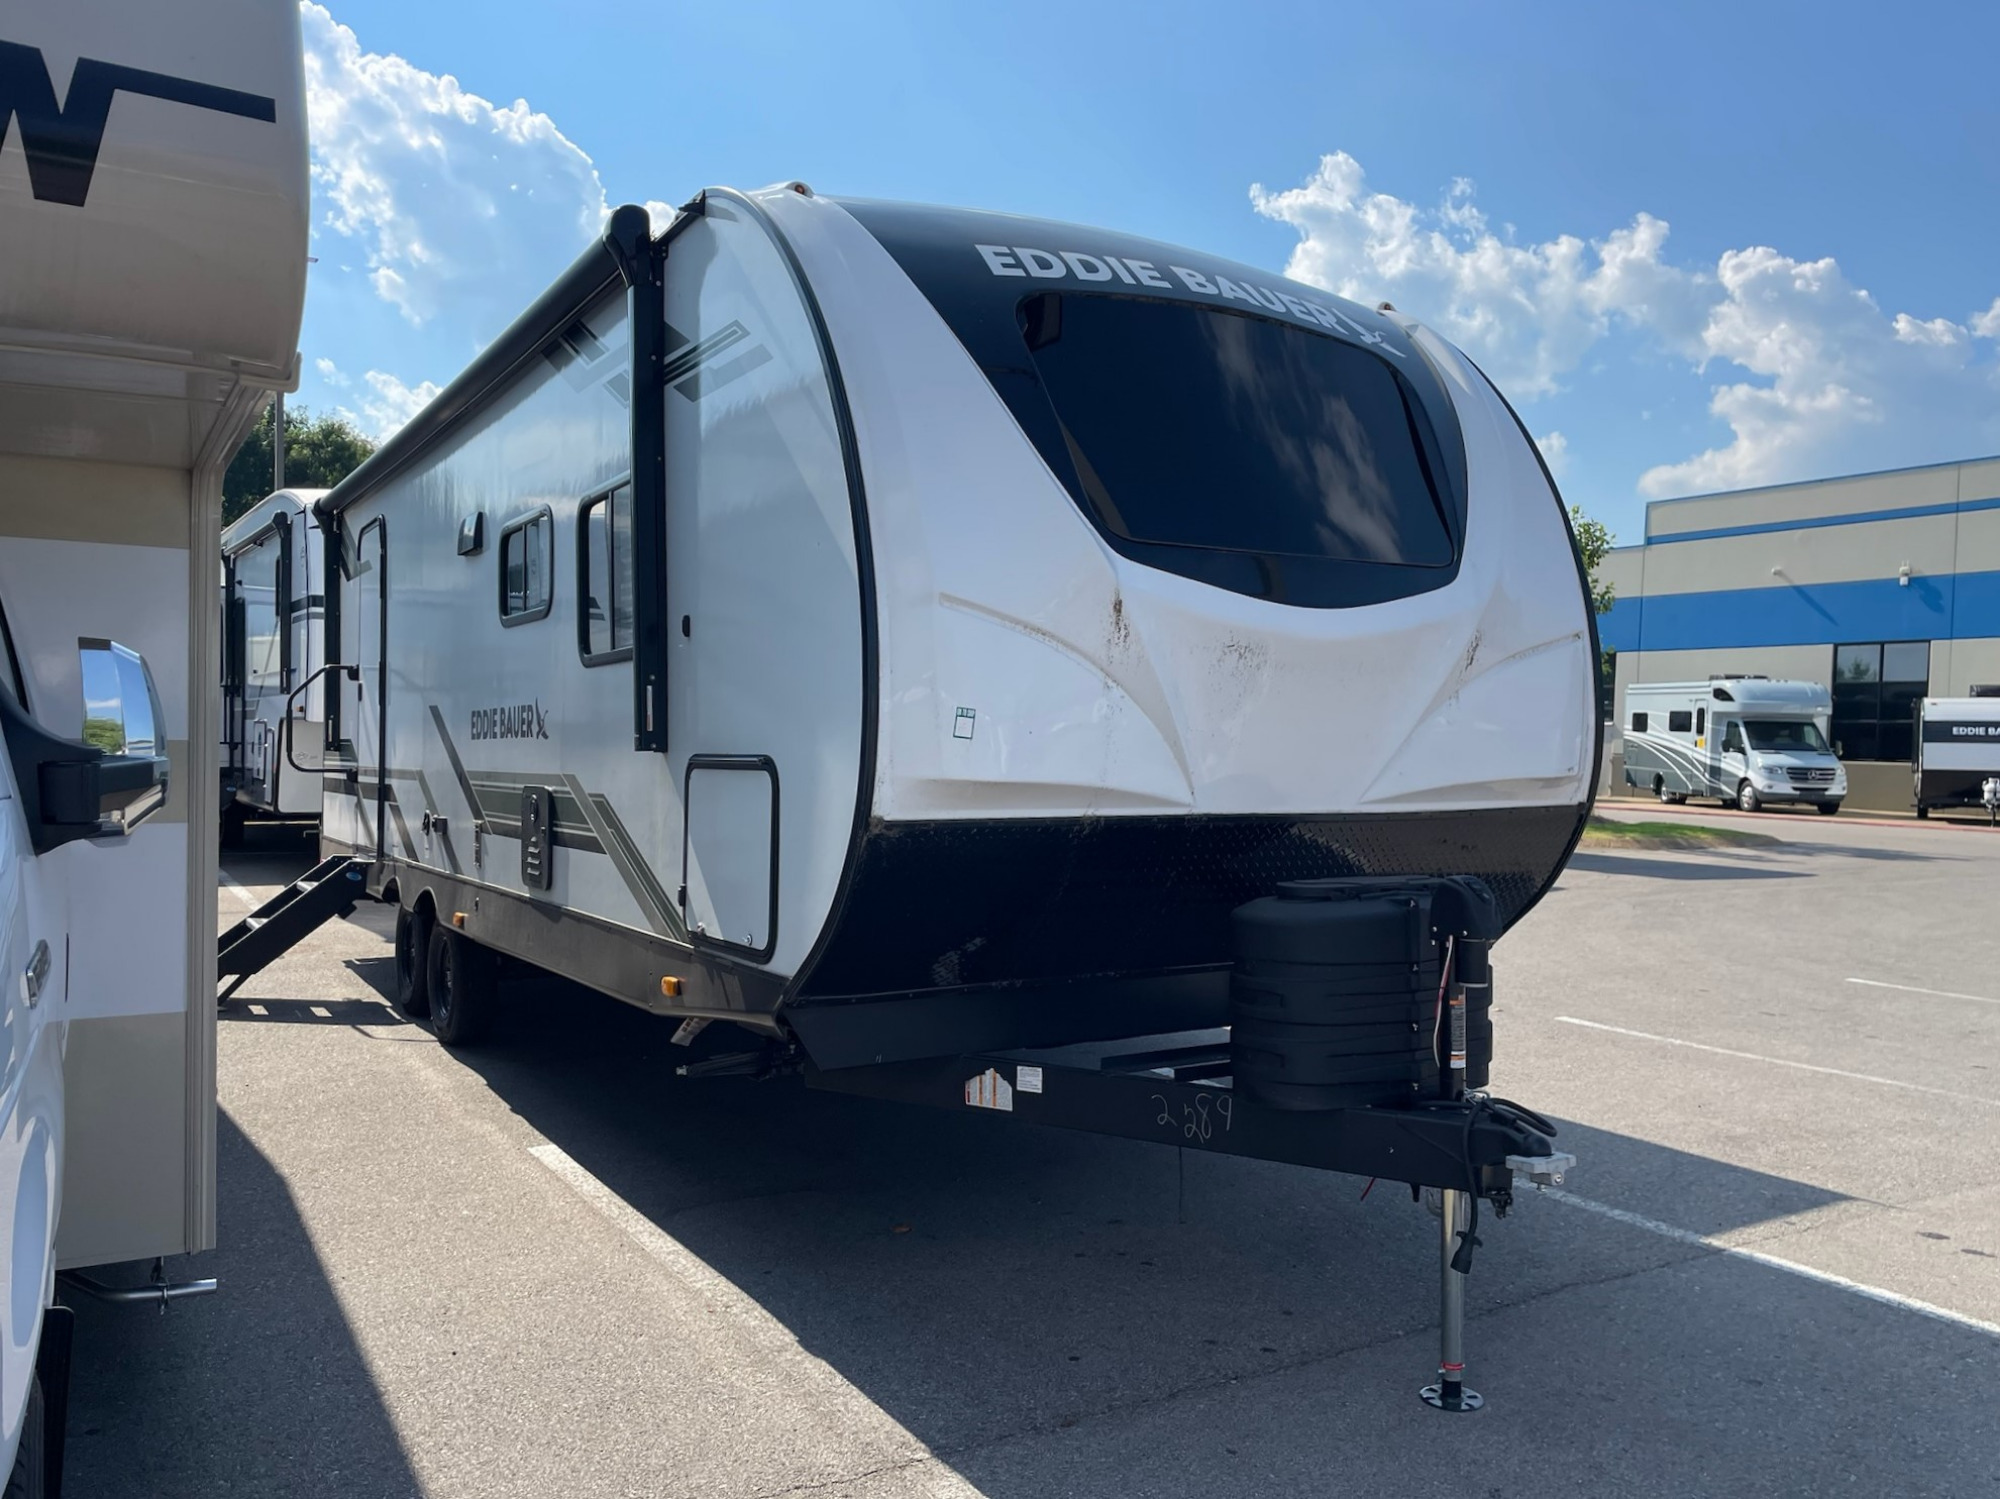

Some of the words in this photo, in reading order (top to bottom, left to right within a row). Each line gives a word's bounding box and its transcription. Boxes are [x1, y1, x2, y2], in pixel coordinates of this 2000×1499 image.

[974, 243, 1173, 289] EDDIE
[1169, 264, 1349, 335] BAUER
[471, 708, 498, 740] EDDIE
[500, 704, 534, 739] BAUER
[1952, 726, 1986, 736] EDDIE
